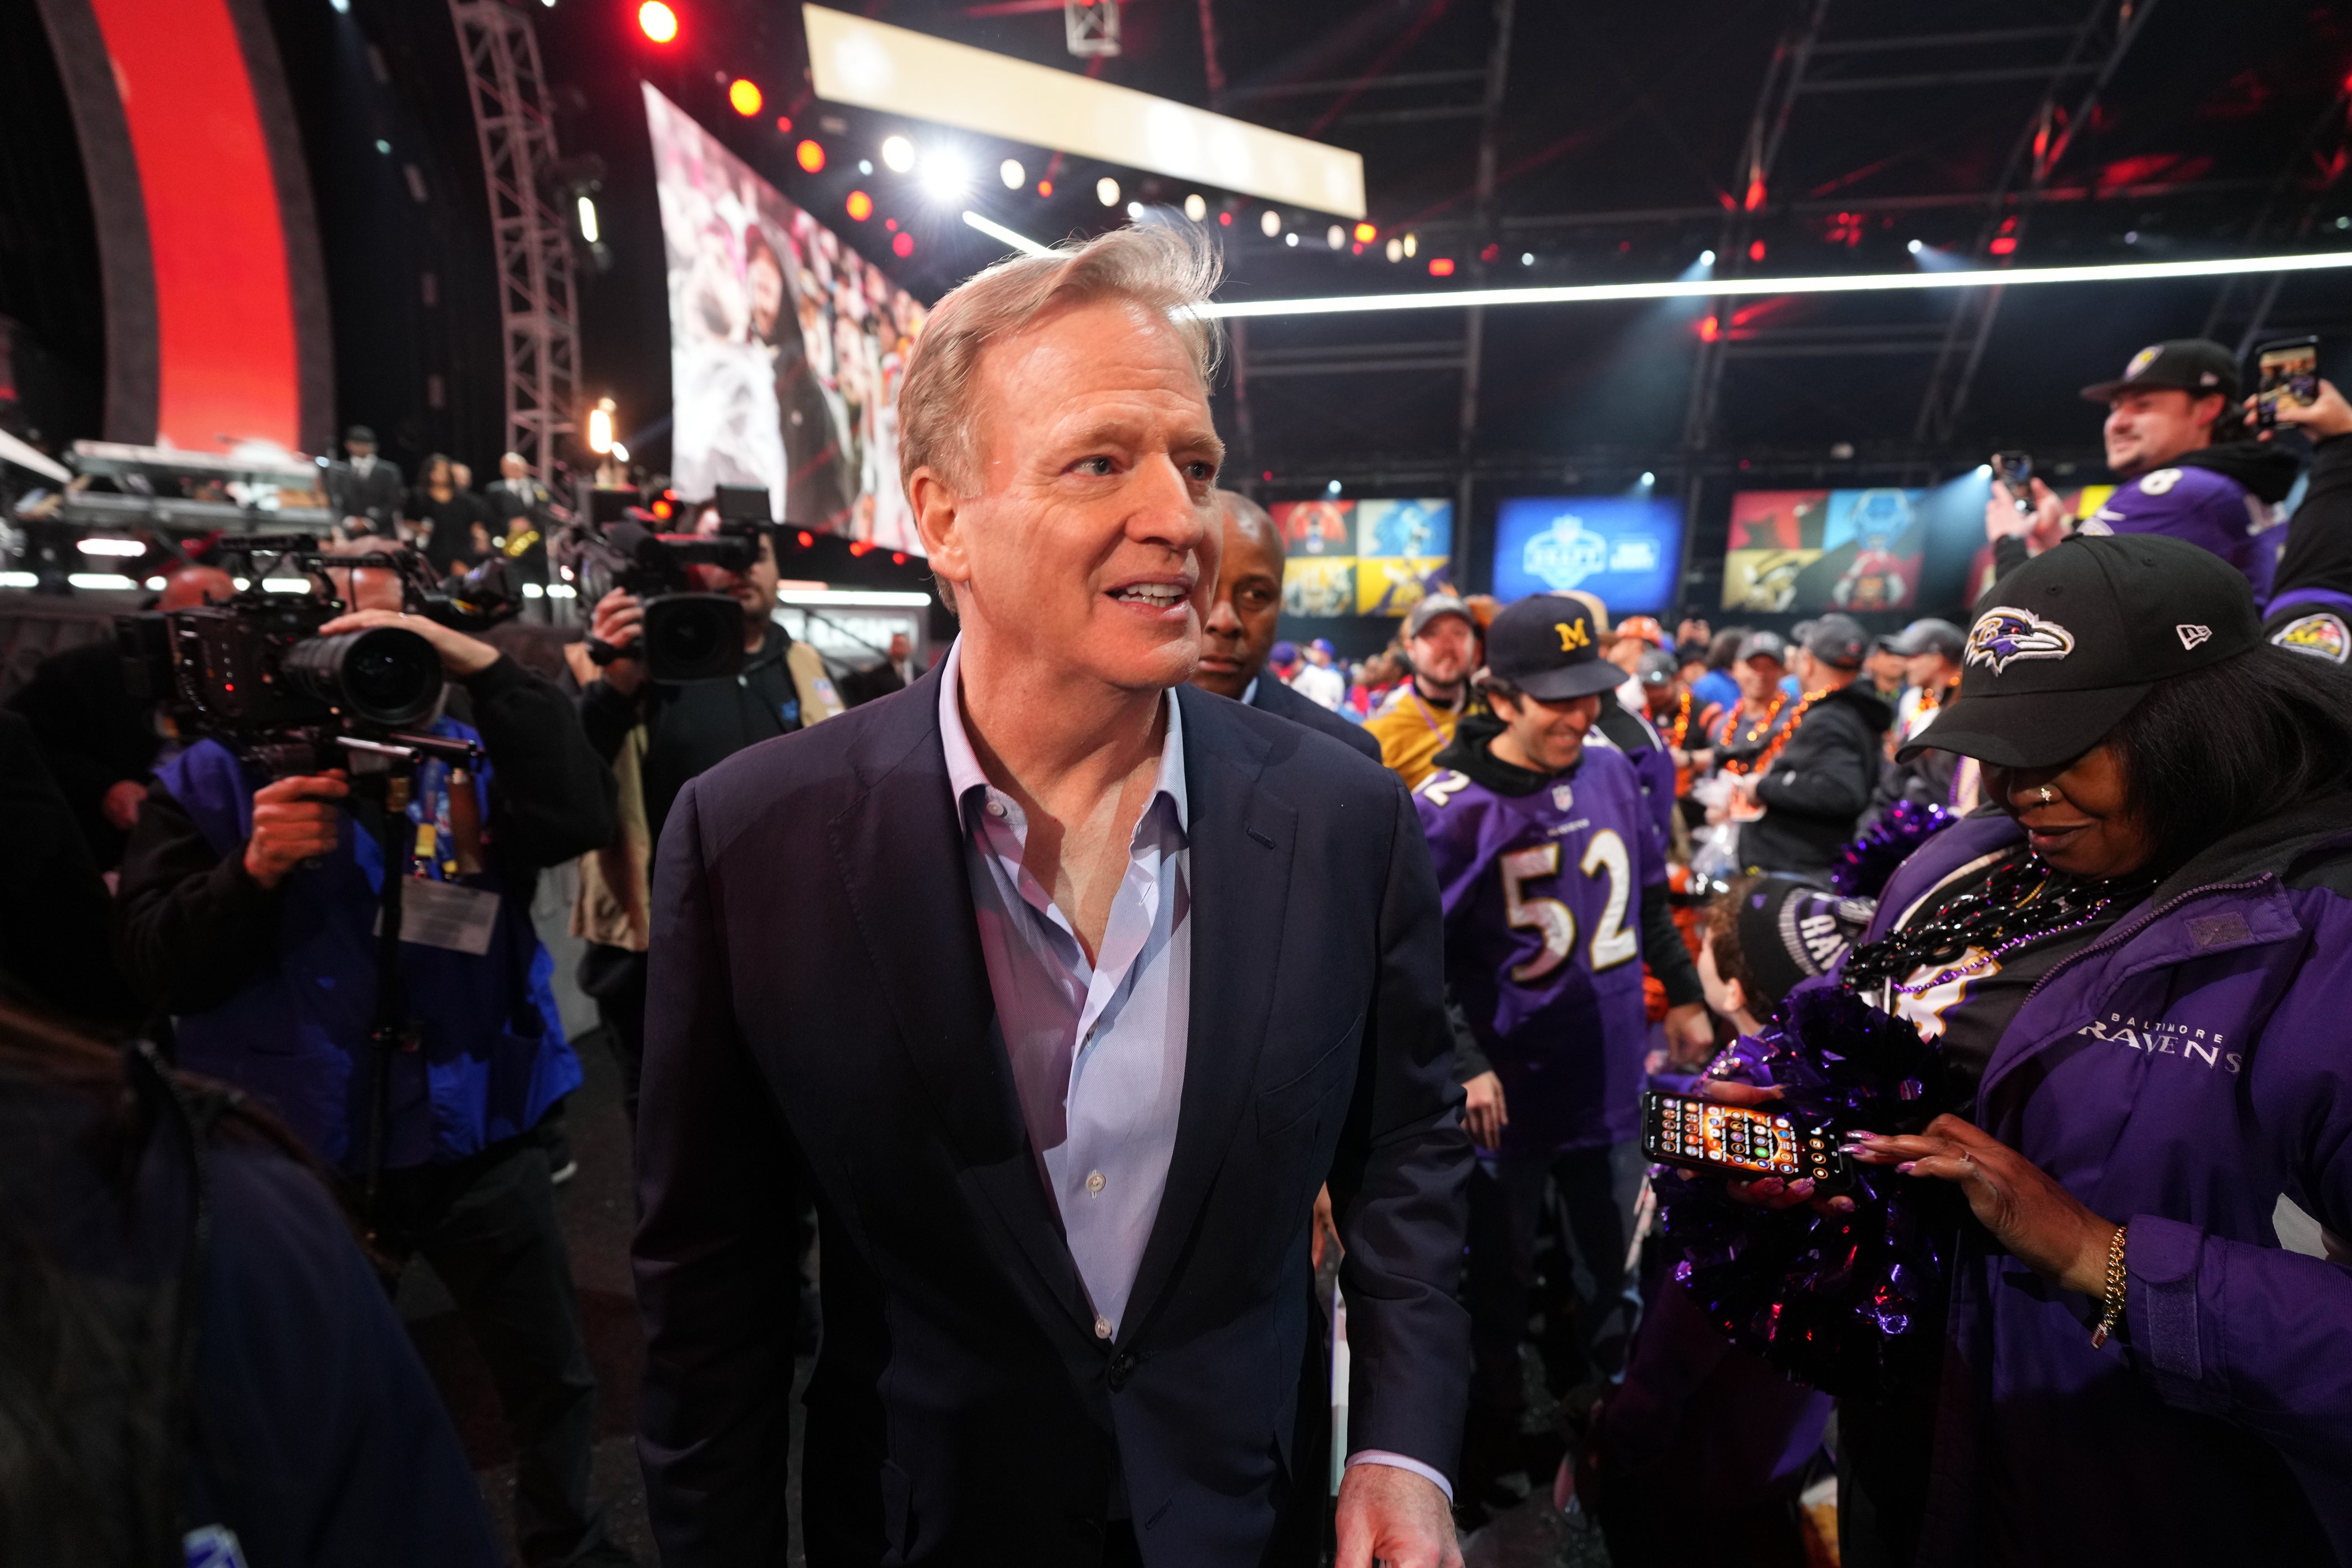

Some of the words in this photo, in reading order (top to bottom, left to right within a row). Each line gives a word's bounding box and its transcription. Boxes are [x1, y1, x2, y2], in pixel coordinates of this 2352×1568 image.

[1554, 617, 1591, 651] M
[1500, 828, 1637, 982] 52
[2077, 1021, 2242, 1074] RAVENS
[2111, 1013, 2223, 1044] BALTIMORE
